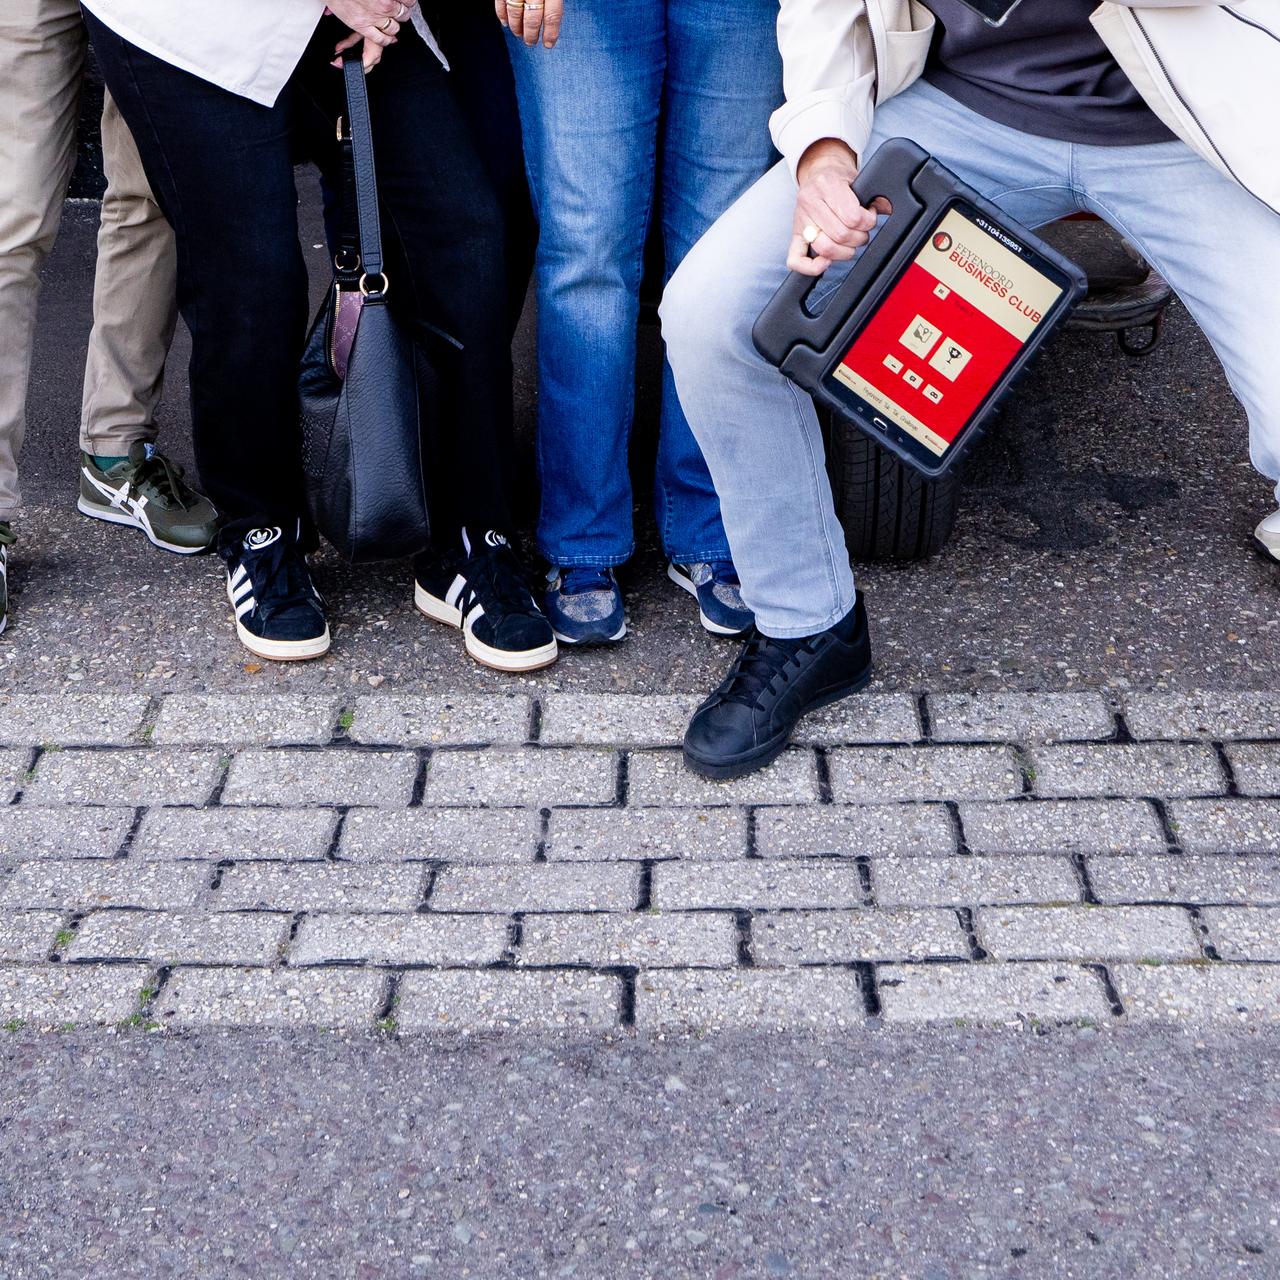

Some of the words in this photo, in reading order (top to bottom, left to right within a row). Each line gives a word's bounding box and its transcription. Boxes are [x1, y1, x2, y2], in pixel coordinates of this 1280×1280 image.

[949, 250, 1008, 298] BUSINESS
[1008, 295, 1042, 324] CLUB
[955, 242, 1014, 290] FEYENOORD
